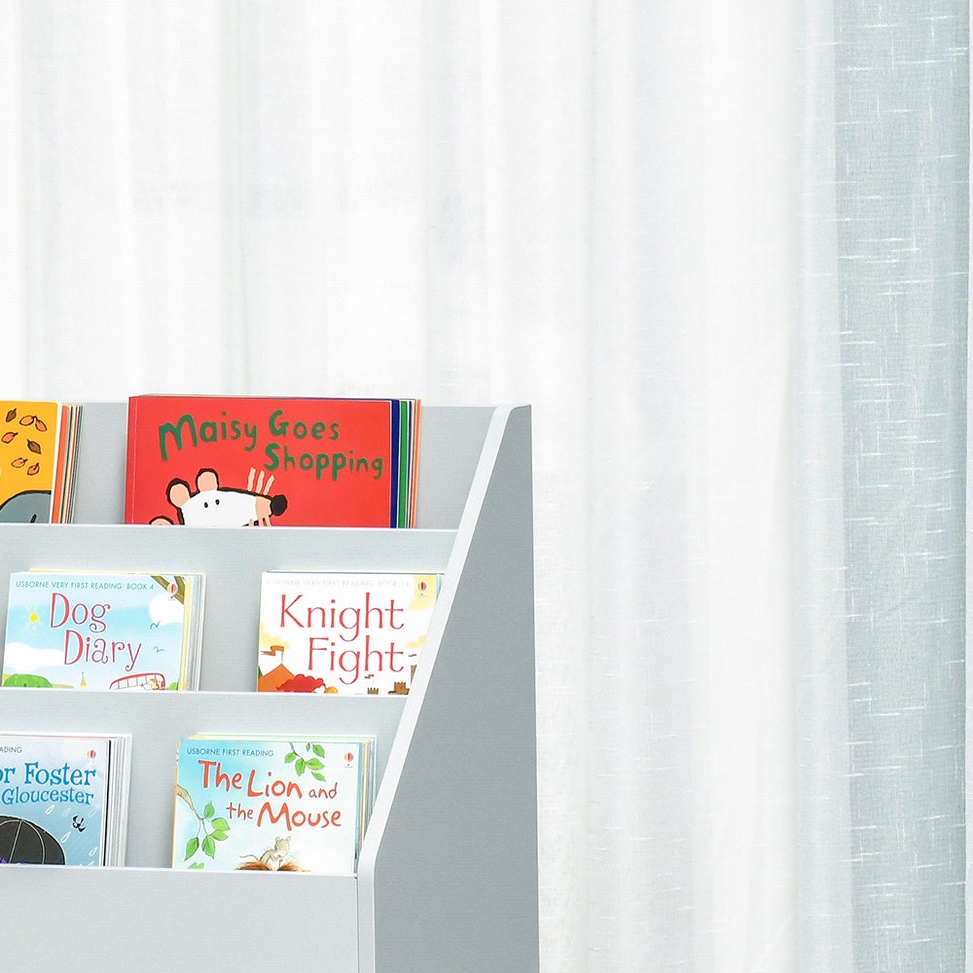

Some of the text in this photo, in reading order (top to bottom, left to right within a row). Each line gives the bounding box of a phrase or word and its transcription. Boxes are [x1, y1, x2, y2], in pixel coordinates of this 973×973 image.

[158, 409, 340, 461] Maisy Goes
[263, 443, 384, 481] Shopping
[15, 581, 49, 589] USBORNE
[51, 581, 68, 589] VERY
[90, 582, 122, 590] READING
[50, 592, 111, 633] Dog
[280, 592, 404, 642] Knight
[64, 629, 143, 672] Diary
[308, 635, 404, 684] Fight
[187, 748, 274, 757] USBORNE FIRST READING
[24, 761, 96, 786] Foster
[198, 759, 338, 799] The Lion and
[1, 786, 94, 805] Gloucester
[226, 801, 342, 831] the Mouse
